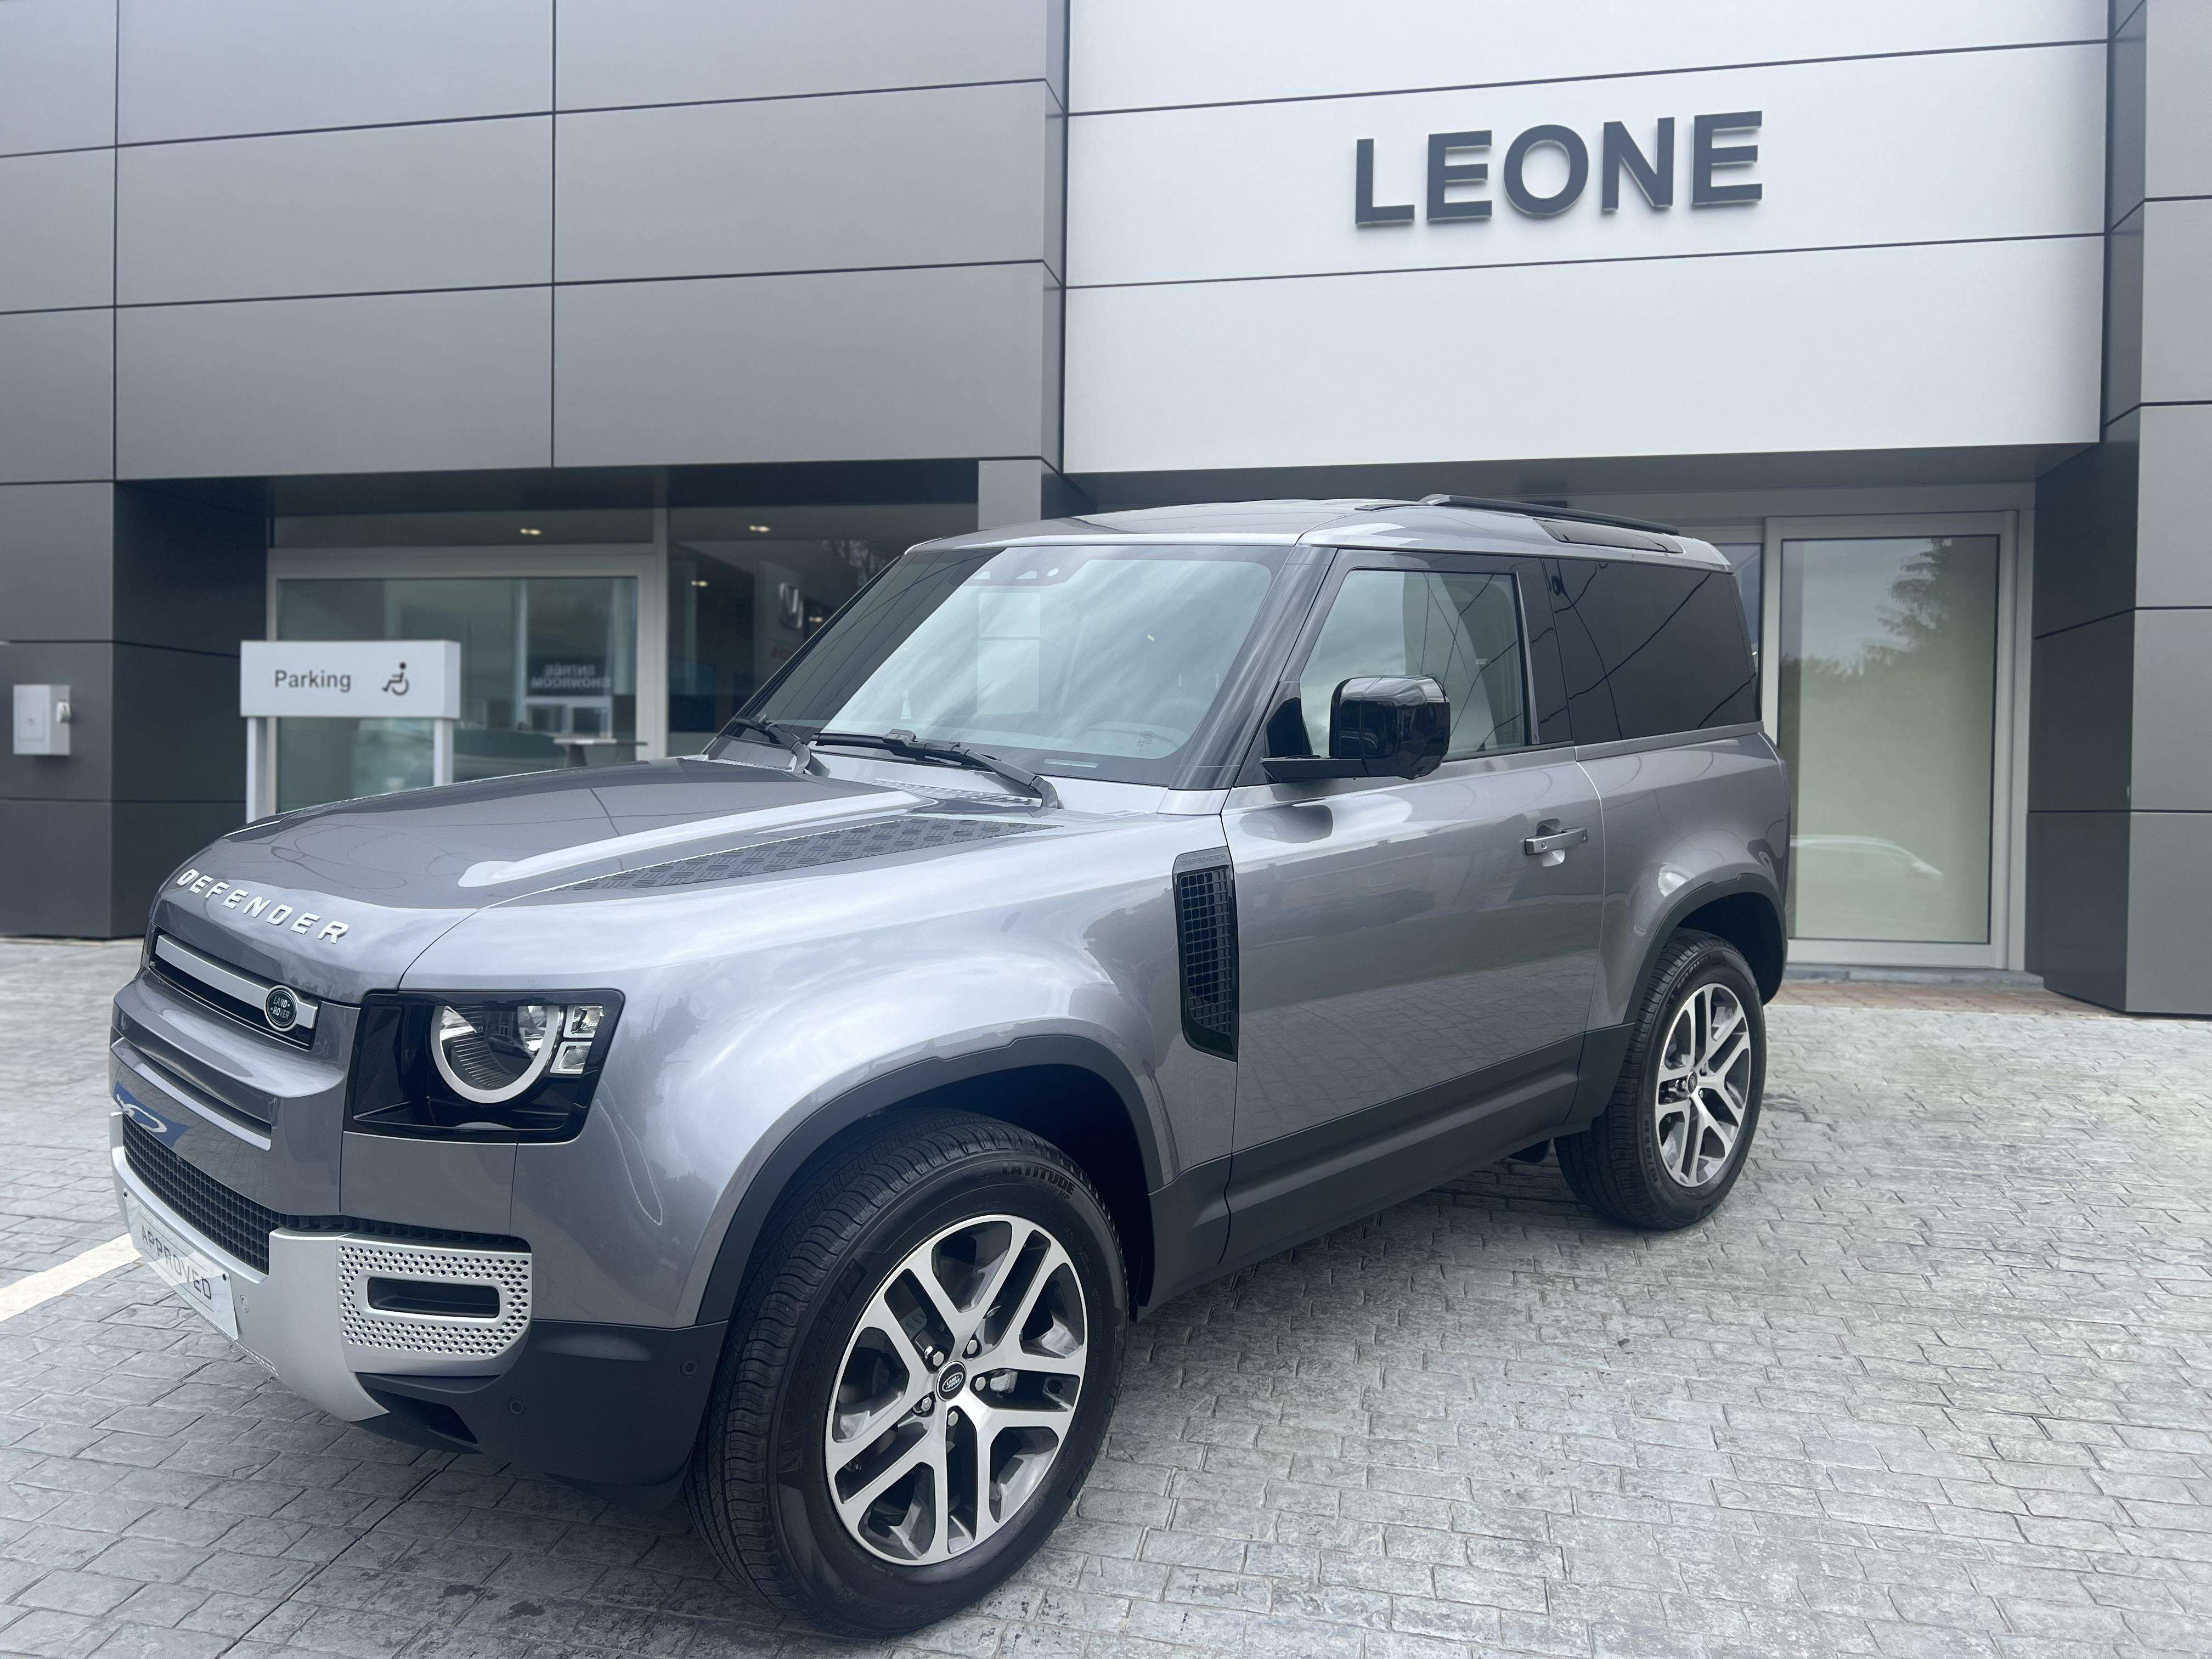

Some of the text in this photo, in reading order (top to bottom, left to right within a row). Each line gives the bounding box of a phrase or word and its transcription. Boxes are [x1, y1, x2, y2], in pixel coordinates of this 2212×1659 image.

[1355, 111, 1763, 224] LEONE
[274, 670, 351, 693] Parking
[1181, 854, 1227, 866] DEFENDER
[176, 868, 350, 944] DEFENDER
[1001, 1162, 1076, 1195] LATITUDE
[142, 1224, 212, 1301] APPROVED
